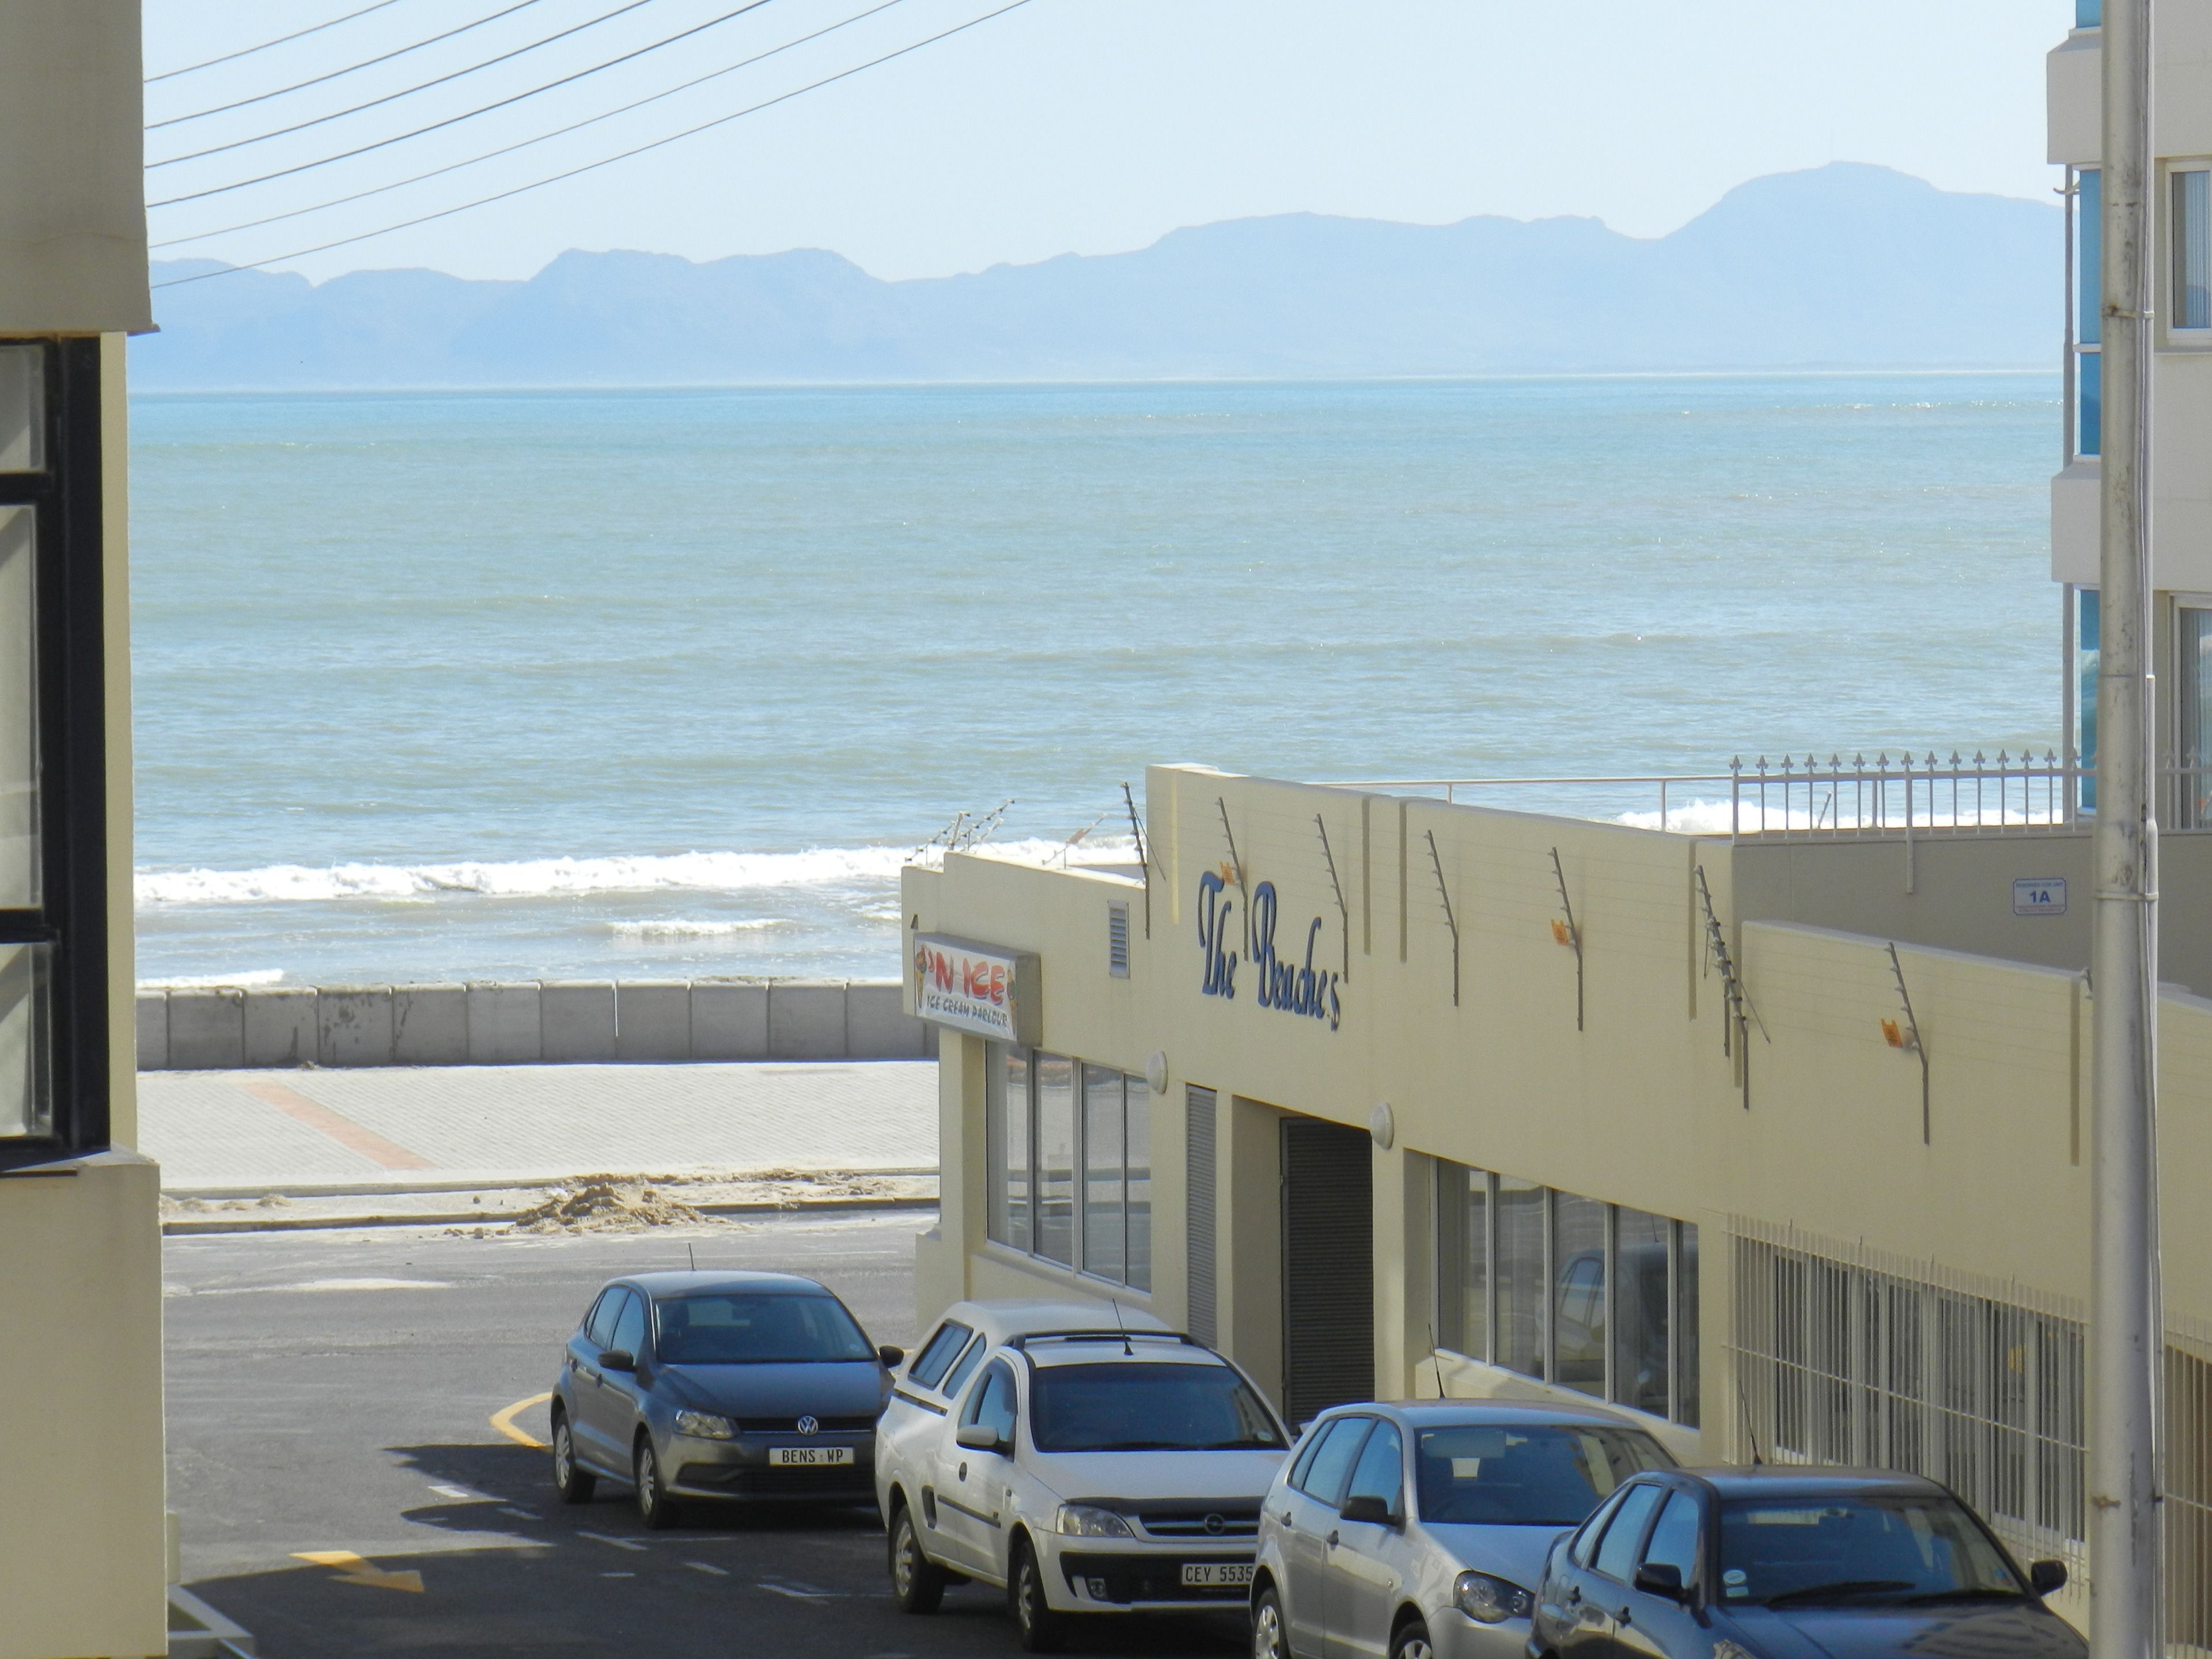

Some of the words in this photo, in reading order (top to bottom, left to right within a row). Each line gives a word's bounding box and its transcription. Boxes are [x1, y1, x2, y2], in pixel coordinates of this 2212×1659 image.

[2029, 890, 2051, 903] 1A
[1198, 870, 1237, 1000] The
[927, 994, 940, 1009] ICE
[943, 998, 969, 1017] CREAM
[972, 1005, 1008, 1027] PARLOUR
[782, 1450, 816, 1463] BENS
[827, 1449, 843, 1463] WP
[1185, 1566, 1211, 1582] CEY
[1219, 1566, 1253, 1582] 5535
